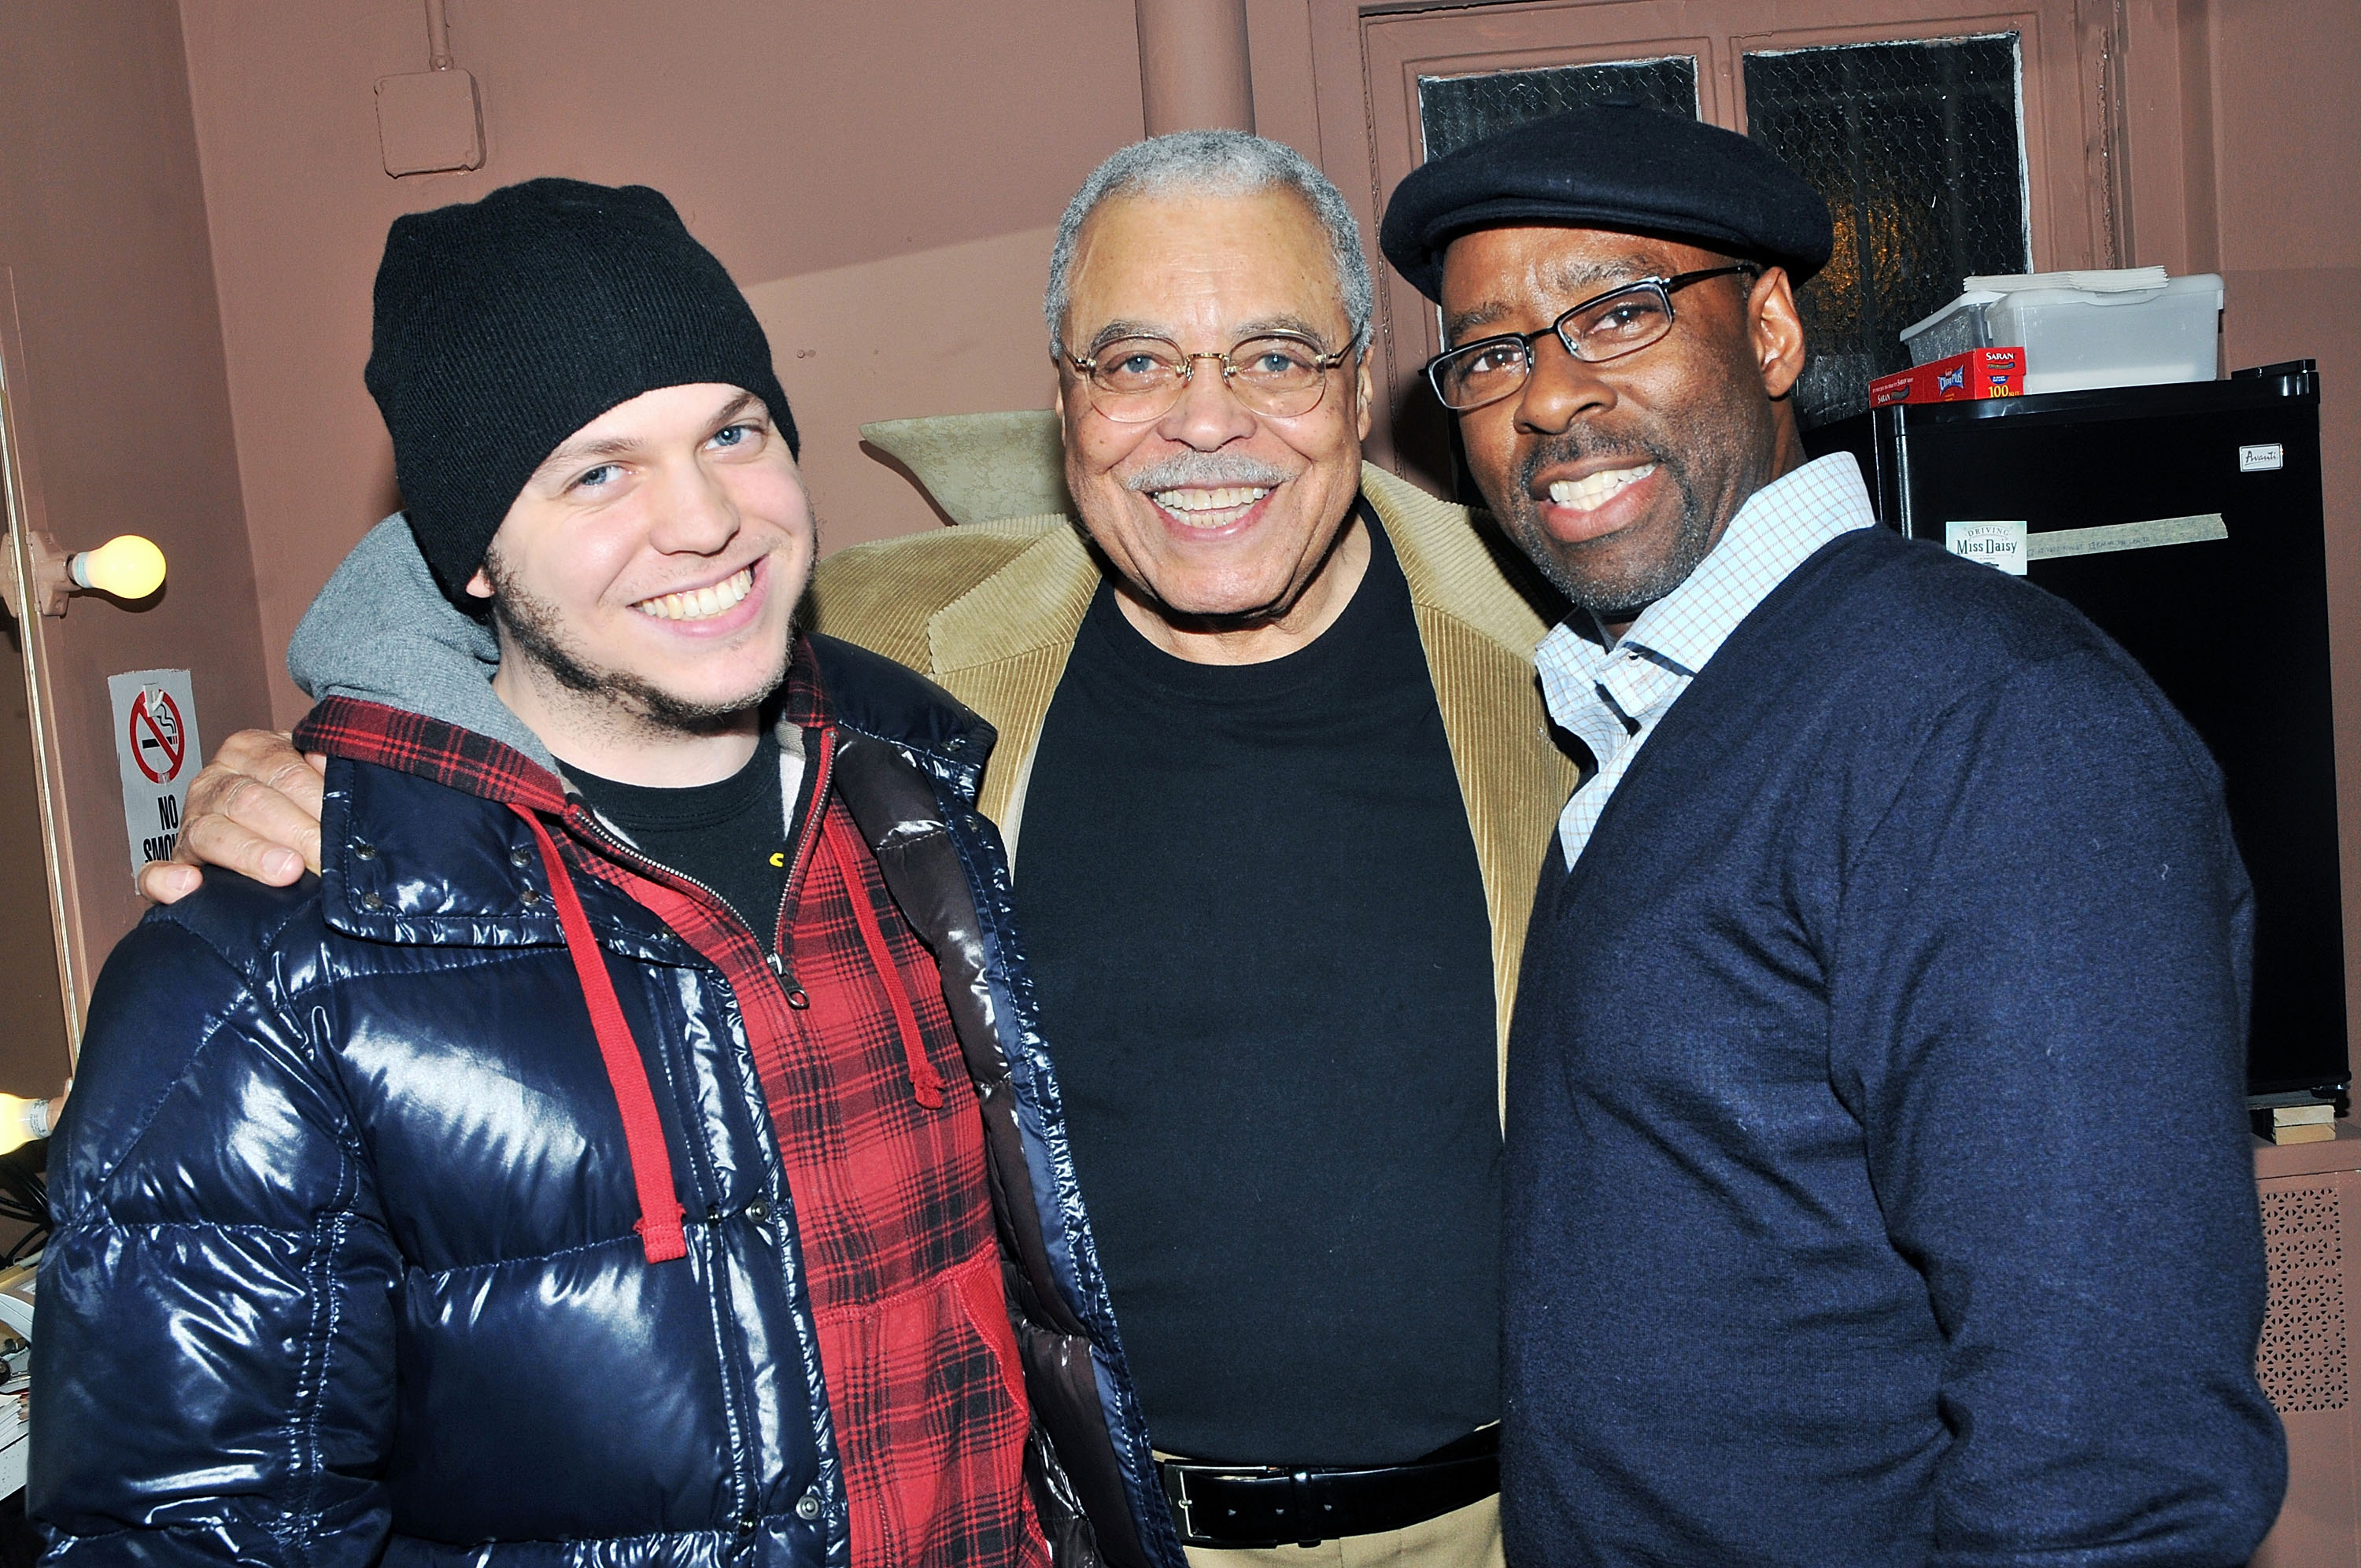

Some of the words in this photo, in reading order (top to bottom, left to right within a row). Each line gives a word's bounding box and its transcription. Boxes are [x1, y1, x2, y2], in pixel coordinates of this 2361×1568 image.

[1988, 385, 2008, 398] 100
[2245, 450, 2276, 463] Avanti
[1968, 526, 2009, 537] DRIVING
[1986, 538, 2017, 554] Daisy
[157, 795, 179, 830] NO
